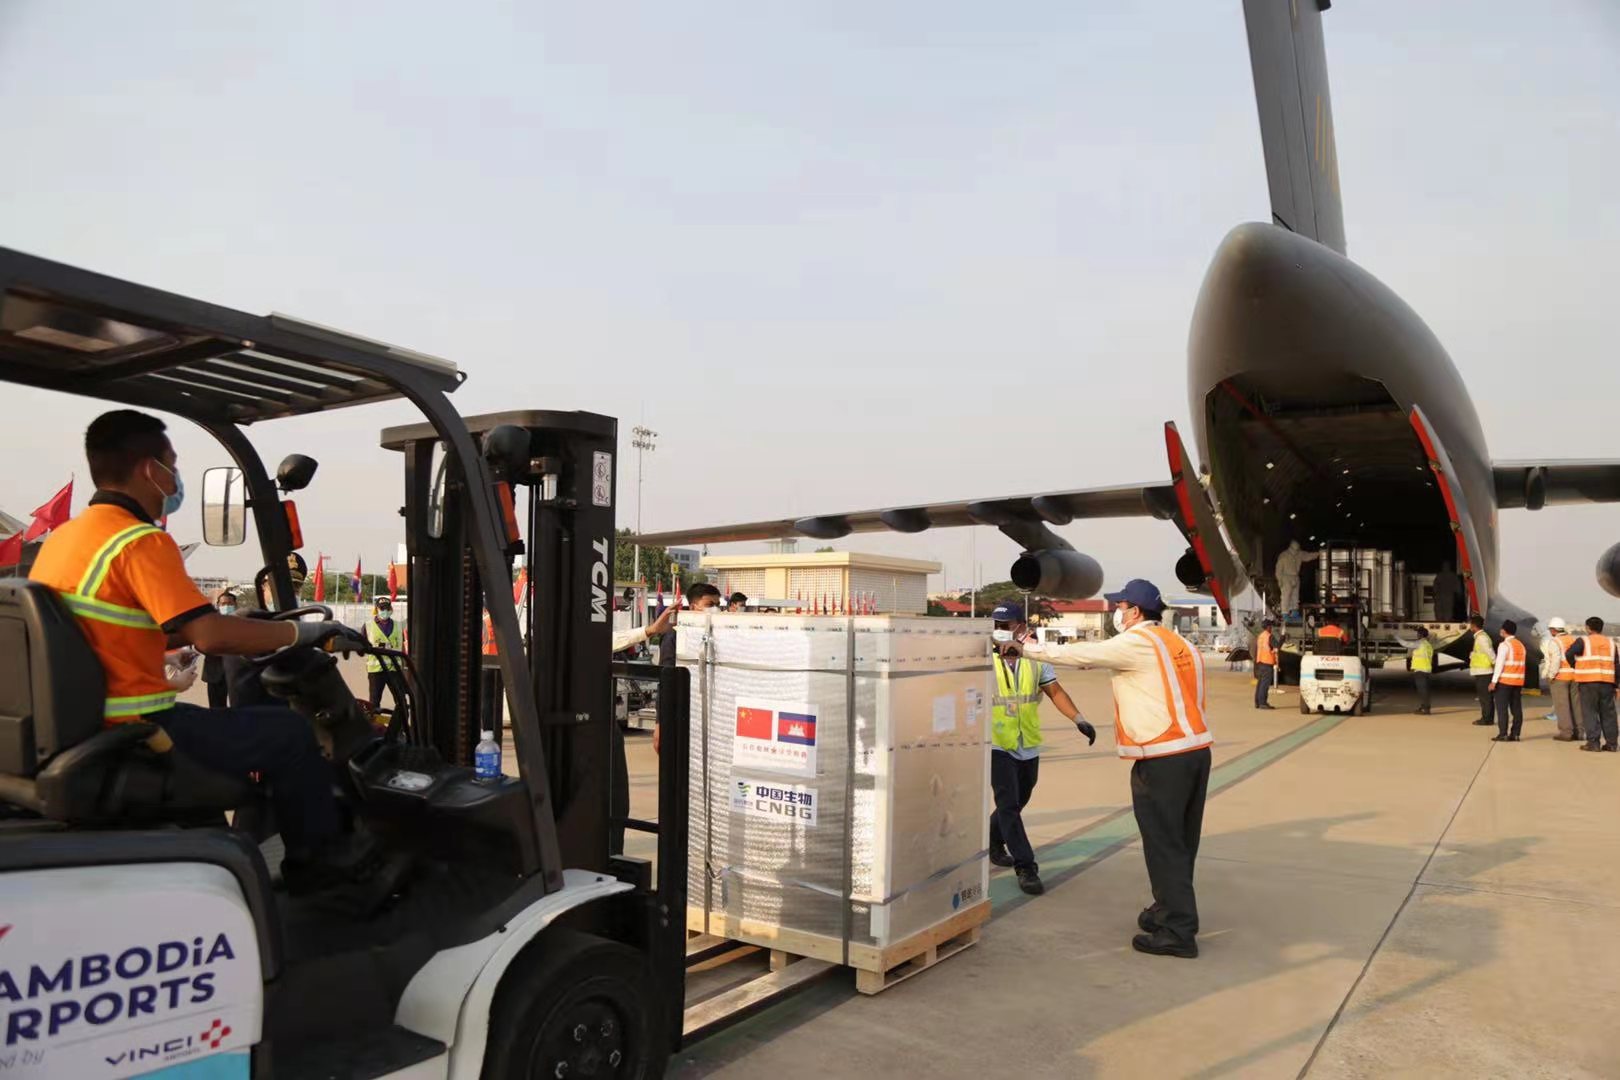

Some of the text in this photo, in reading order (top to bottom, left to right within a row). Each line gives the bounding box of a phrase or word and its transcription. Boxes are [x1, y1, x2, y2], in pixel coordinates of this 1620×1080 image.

[591, 537, 608, 622] TCM
[756, 786, 812, 806] 中国生物
[755, 800, 812, 819] CNBG
[105, 1036, 192, 1065] VINCI
